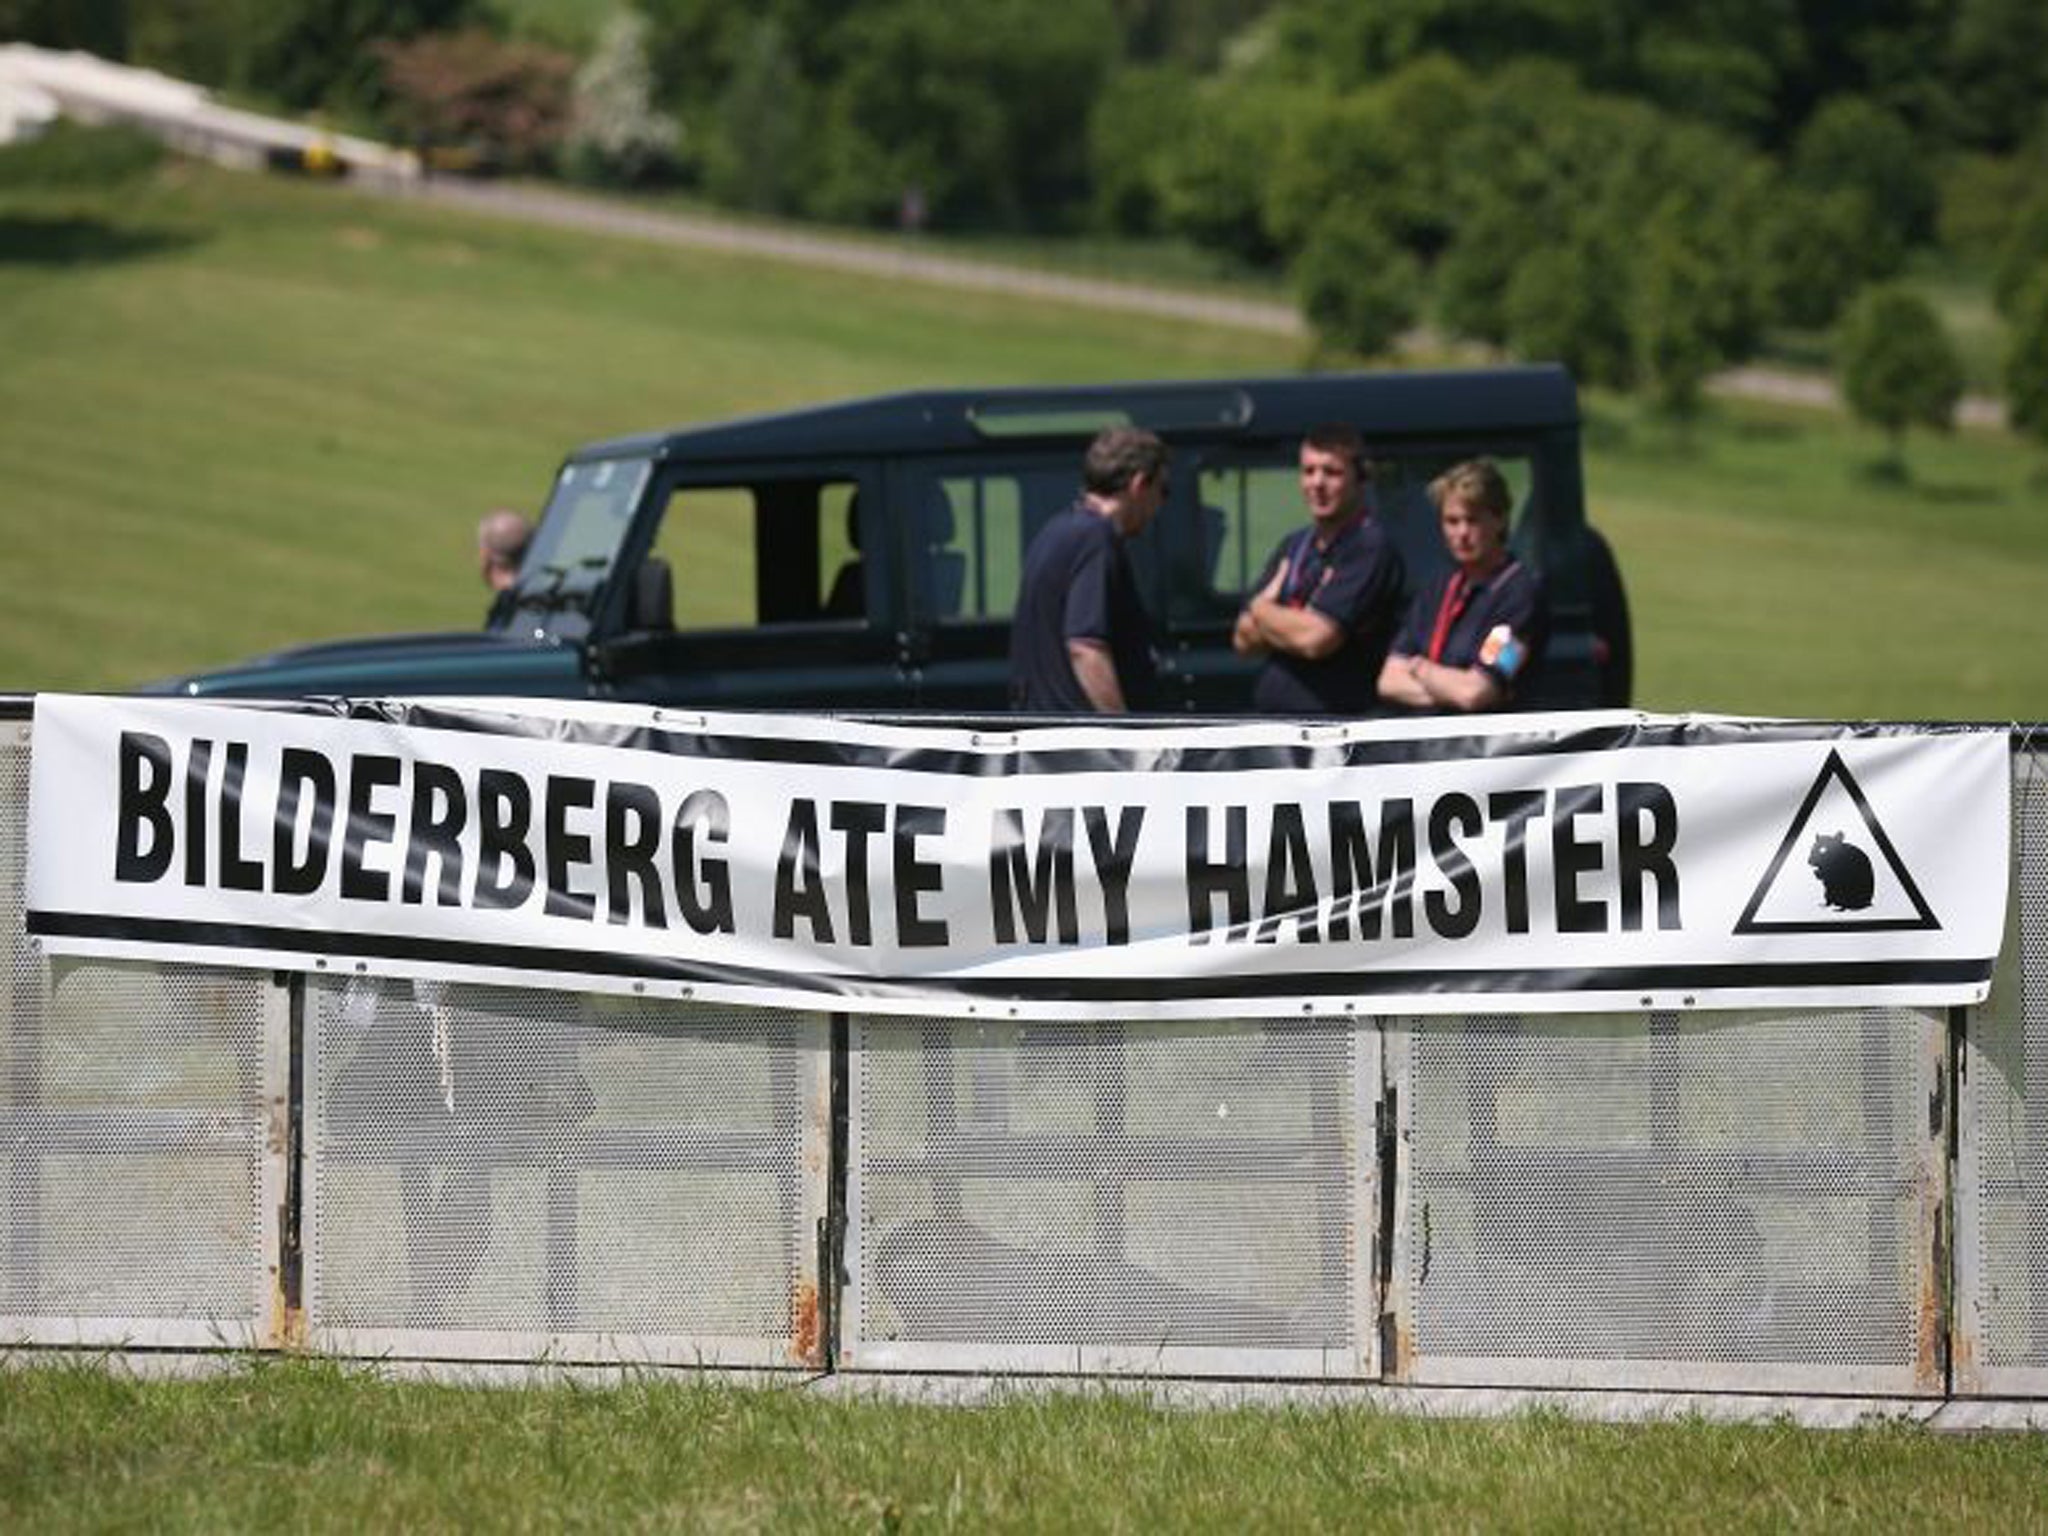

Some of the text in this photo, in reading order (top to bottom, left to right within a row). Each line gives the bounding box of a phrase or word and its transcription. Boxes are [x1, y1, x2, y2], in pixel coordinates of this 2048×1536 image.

[114, 730, 1682, 948] BILDERBERG ATE MY HAMSTER
